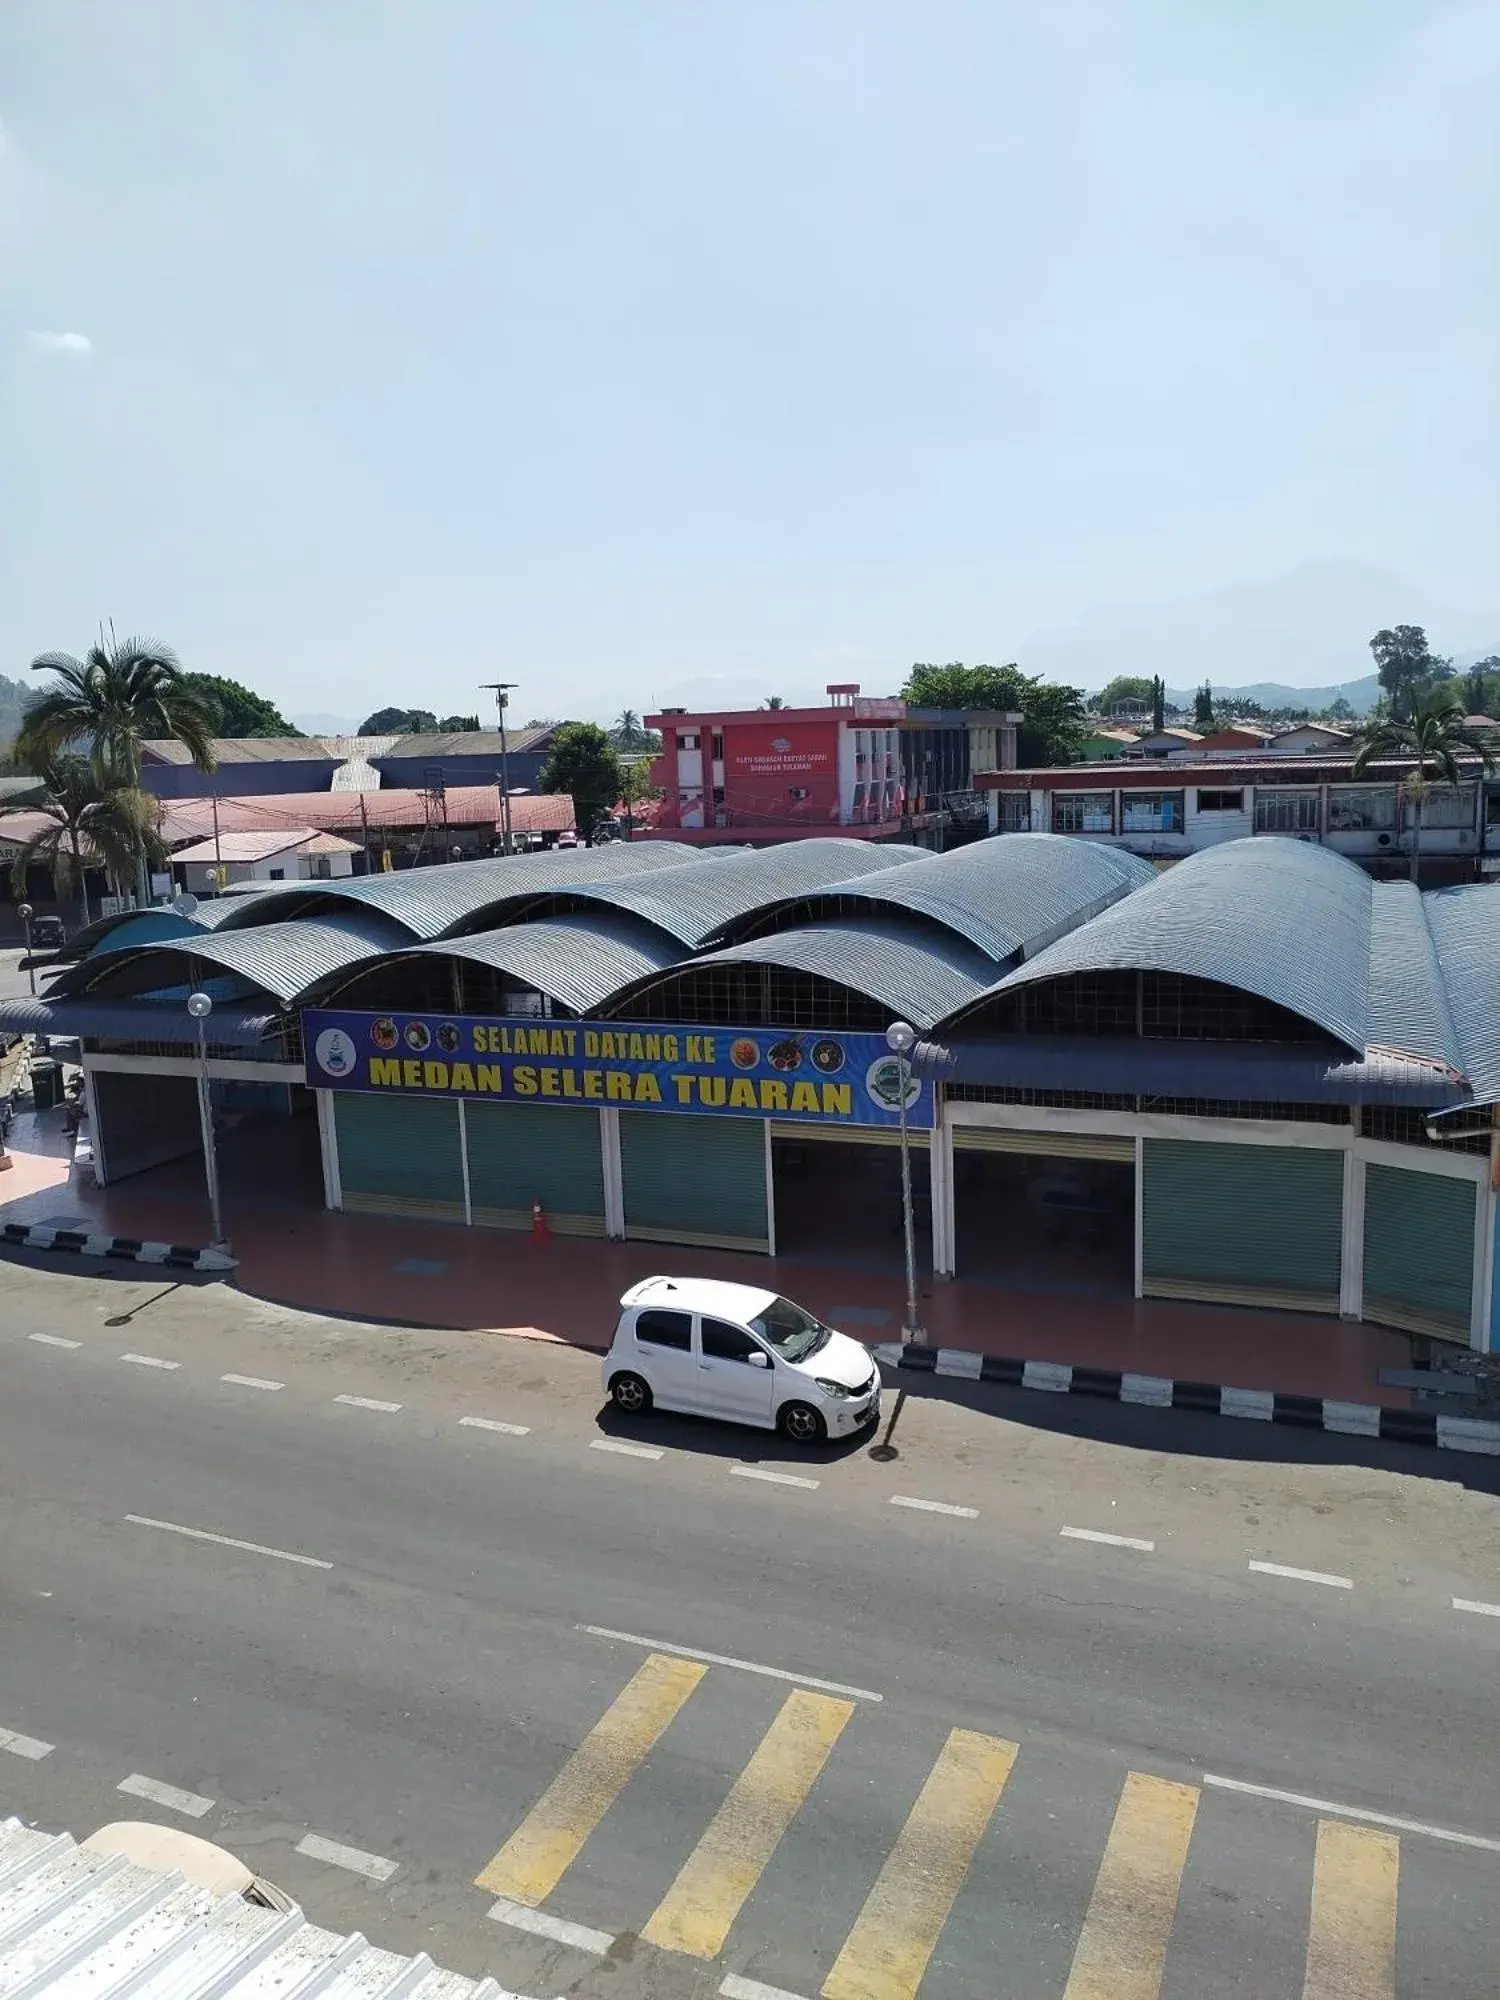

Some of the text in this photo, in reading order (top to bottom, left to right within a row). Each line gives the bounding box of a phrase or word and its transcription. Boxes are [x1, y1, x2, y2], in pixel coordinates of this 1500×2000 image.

[472, 1025, 715, 1063] SELAMAT DATANG KE
[369, 1057, 851, 1114] MEDAN SELERA TUARAN
